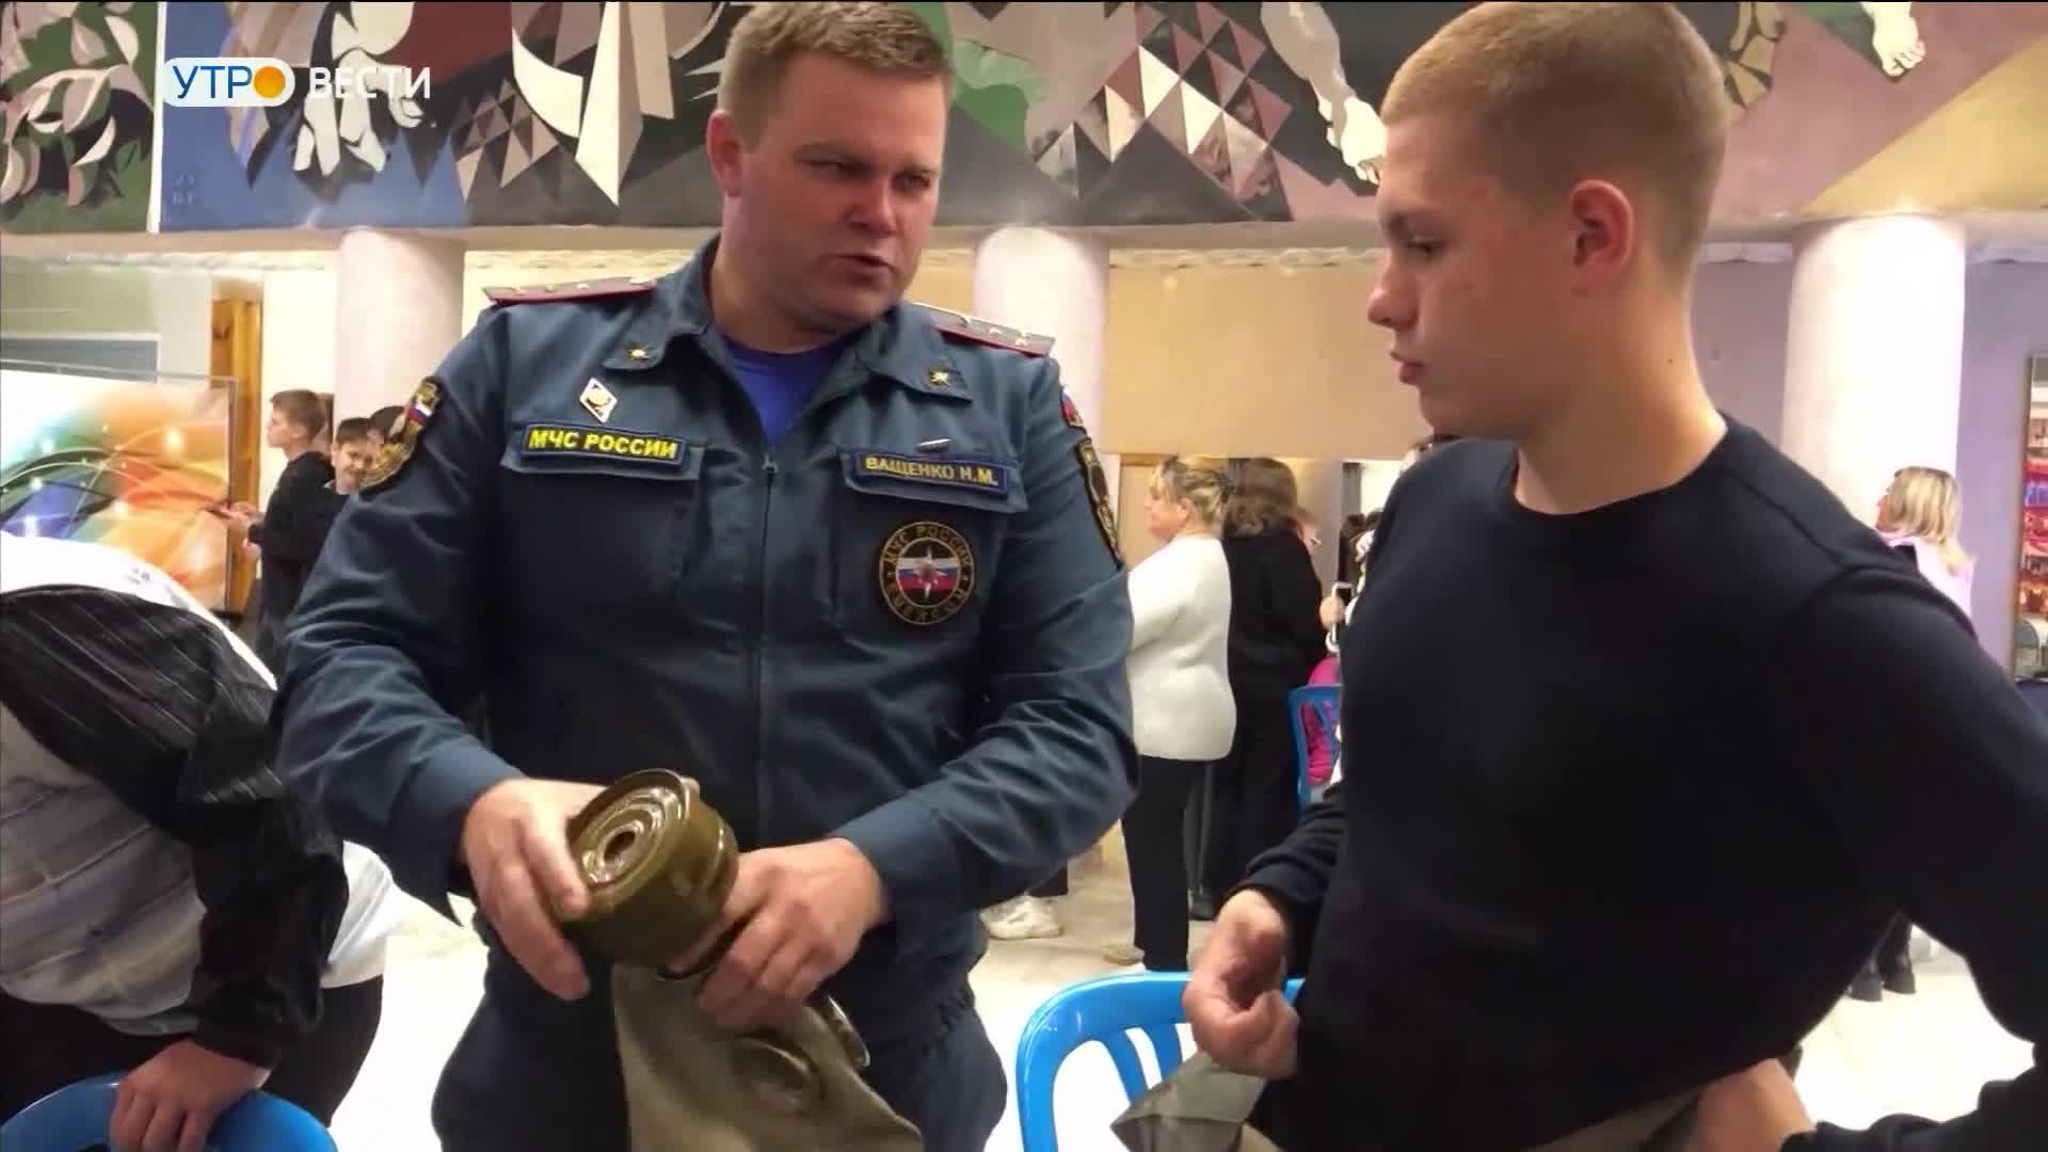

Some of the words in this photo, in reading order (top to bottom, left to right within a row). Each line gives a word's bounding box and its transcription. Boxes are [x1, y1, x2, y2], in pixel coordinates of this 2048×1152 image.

[528, 429, 579, 450] МЧС
[583, 432, 678, 460] РОССИИ
[864, 456, 954, 479] ВАЩЕНКО
[959, 466, 999, 487] Н.М.
